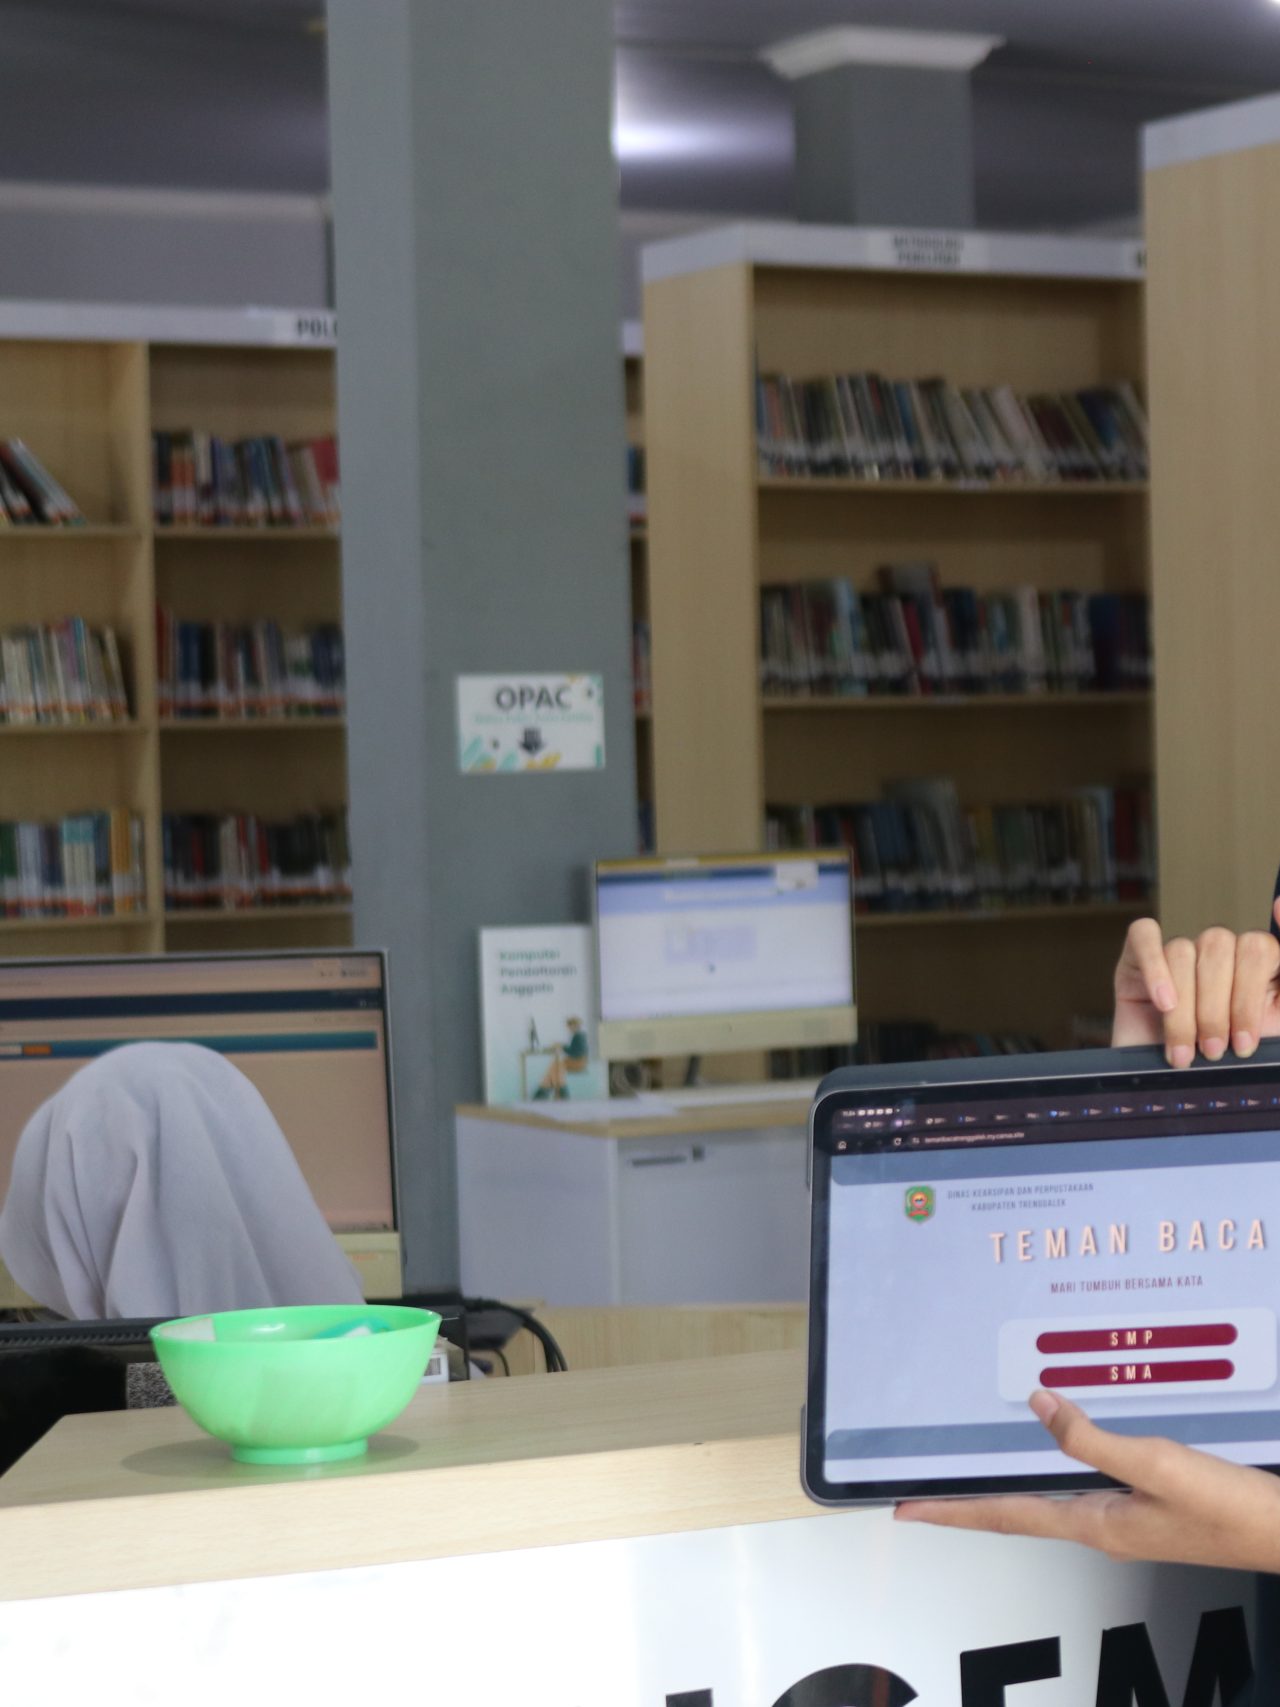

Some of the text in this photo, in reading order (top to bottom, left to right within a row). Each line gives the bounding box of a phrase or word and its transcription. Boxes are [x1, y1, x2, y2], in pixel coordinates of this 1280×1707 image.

[495, 685, 572, 711] OPAC
[1017, 1185, 1033, 1196] DAN
[989, 1219, 1268, 1264] TEMAN BACA
[1050, 1275, 1204, 1295] MARI TUMBUH BERSAMA KATA
